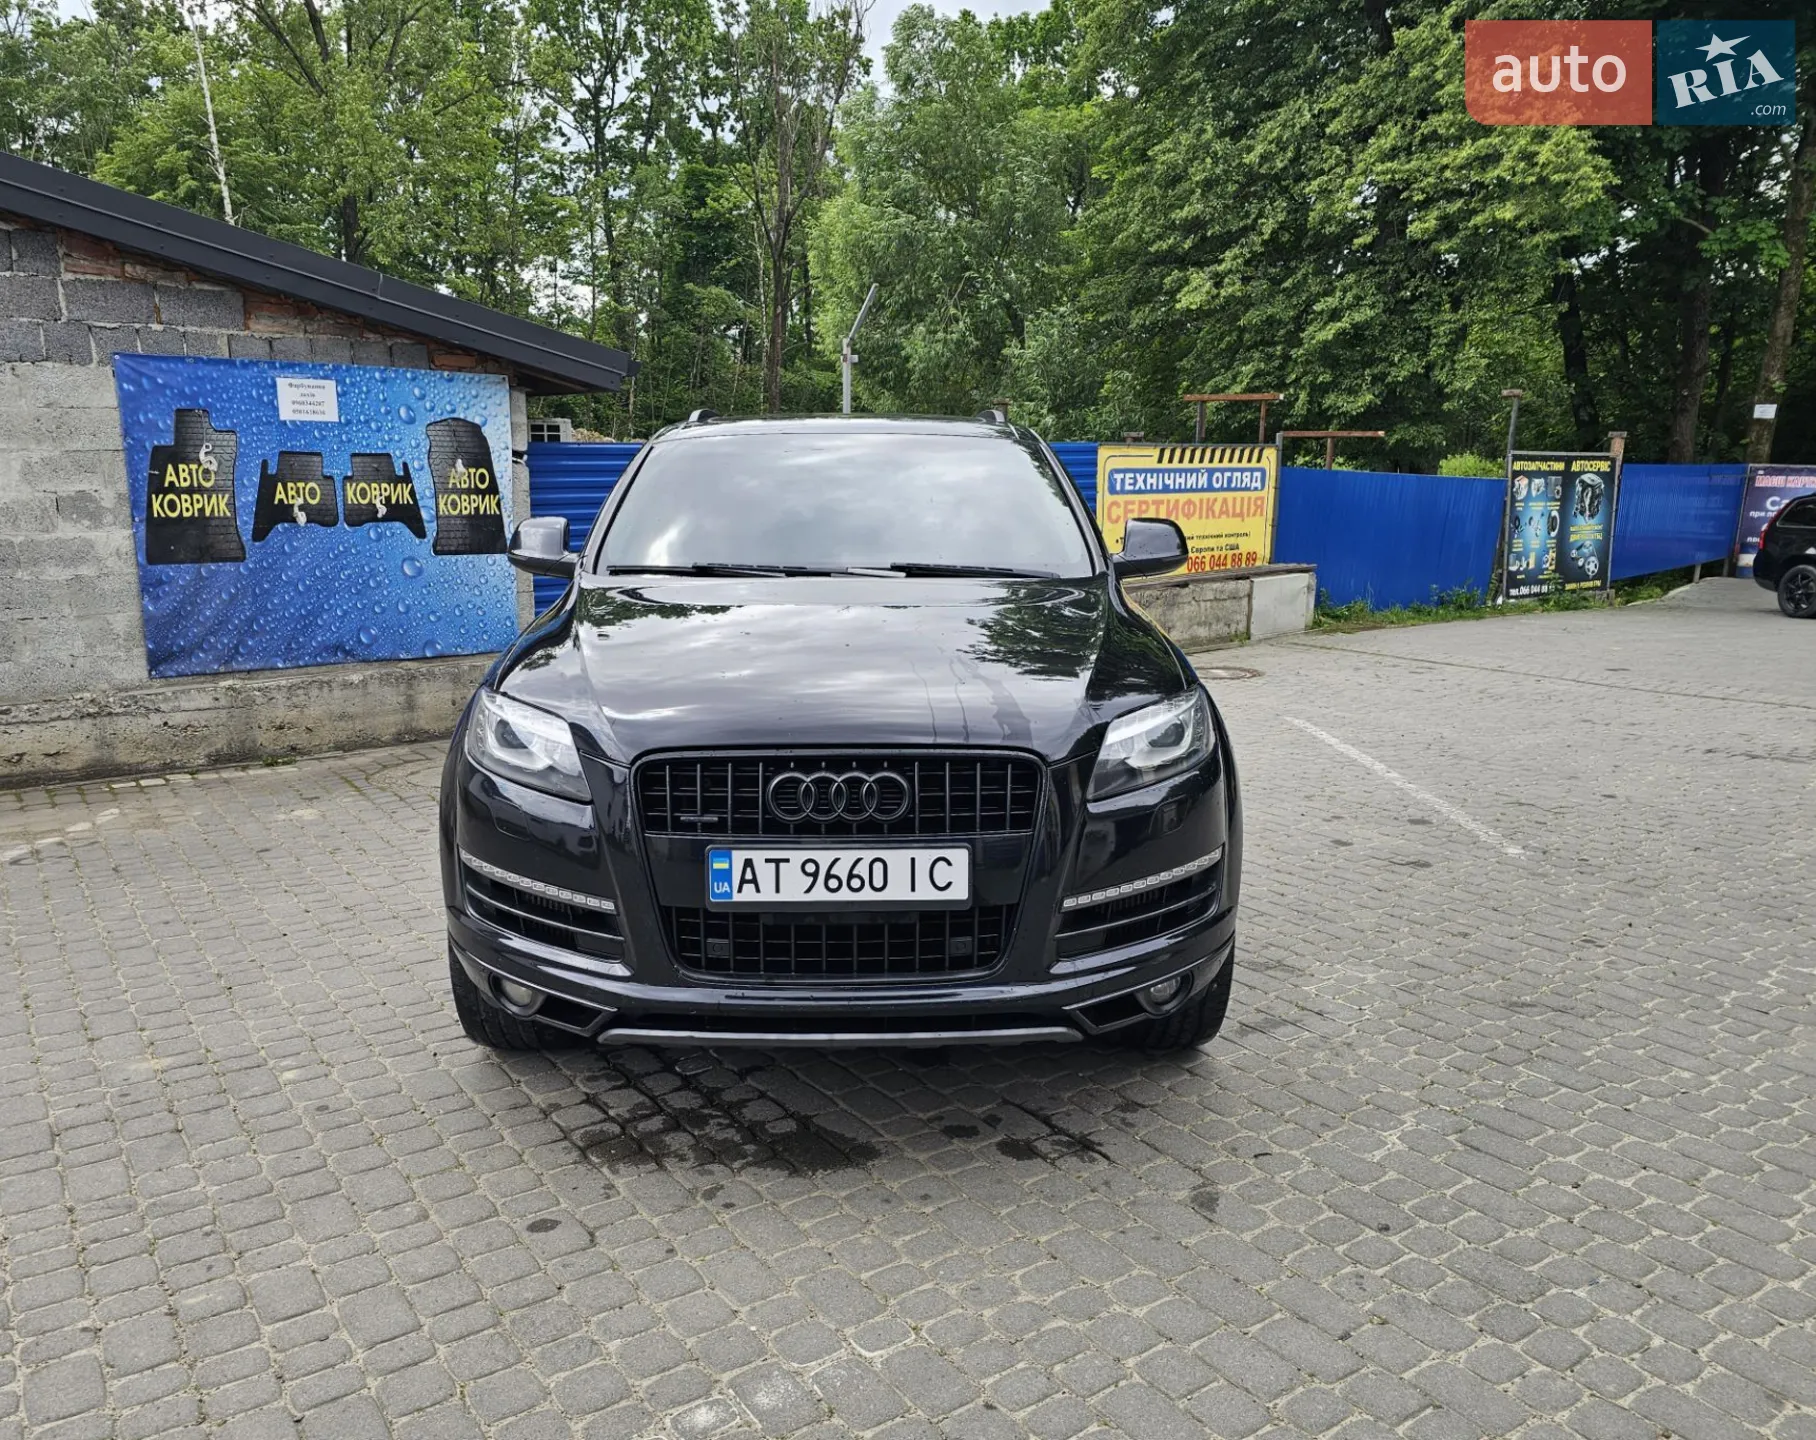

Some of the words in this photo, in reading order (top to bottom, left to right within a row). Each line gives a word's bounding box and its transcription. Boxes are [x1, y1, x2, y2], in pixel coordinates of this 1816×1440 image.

[164, 463, 216, 488] АВТО
[1512, 461, 1565, 472] АВТОЗАПЧАСТИНИ
[1571, 460, 1611, 472] АВТОСЕРВІС
[448, 467, 490, 489] АВТО
[1114, 469, 1208, 491] ТЕХНІЧНИЙ
[1212, 471, 1262, 490] ОГЛЯД
[274, 481, 321, 505] АВТО
[346, 482, 414, 505] КОВРИК
[152, 493, 231, 518] КОВРИК
[438, 494, 500, 516] КОВРИК
[1106, 496, 1266, 525] СЕРТИФІКАЦІЯ
[1225, 543, 1240, 551] США
[1187, 555, 1206, 572] 066
[1209, 554, 1228, 570] 044
[1231, 552, 1243, 568] 88
[1245, 551, 1258, 567] 89
[737, 857, 790, 894] AT
[801, 857, 889, 894] 9660
[910, 856, 954, 893] IC
[714, 882, 730, 894] UA
